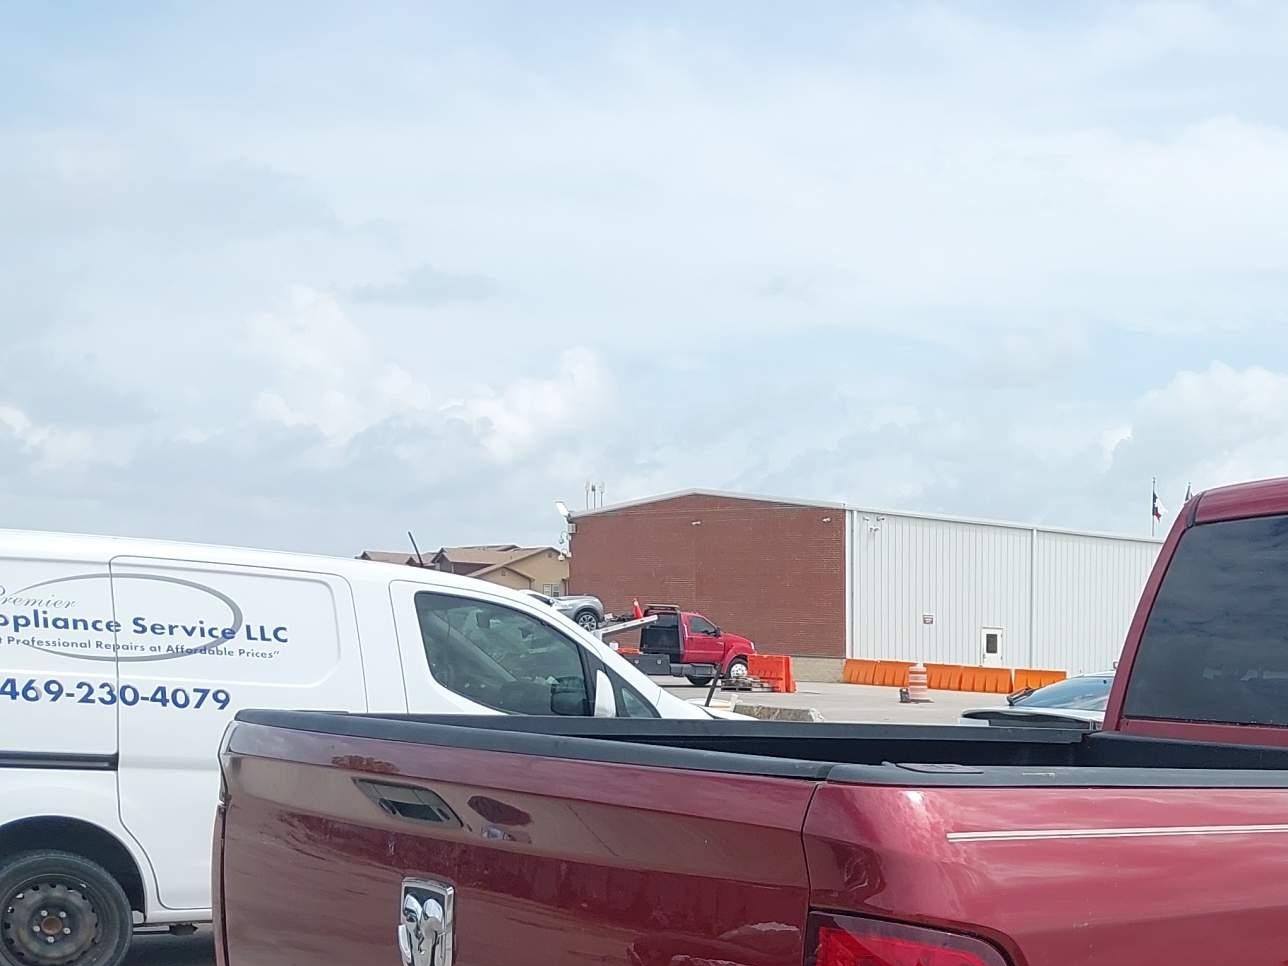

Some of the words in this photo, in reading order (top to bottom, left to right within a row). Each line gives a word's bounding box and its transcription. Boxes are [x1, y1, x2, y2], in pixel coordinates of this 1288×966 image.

[0, 585, 79, 609] remier
[132, 616, 236, 640] Service
[245, 624, 288, 643] LLC
[7, 635, 91, 650] Professional
[95, 640, 145, 652] Repairs
[149, 644, 161, 652] at
[166, 644, 234, 657] Affordable
[0, 678, 231, 711] 469-230-4079
